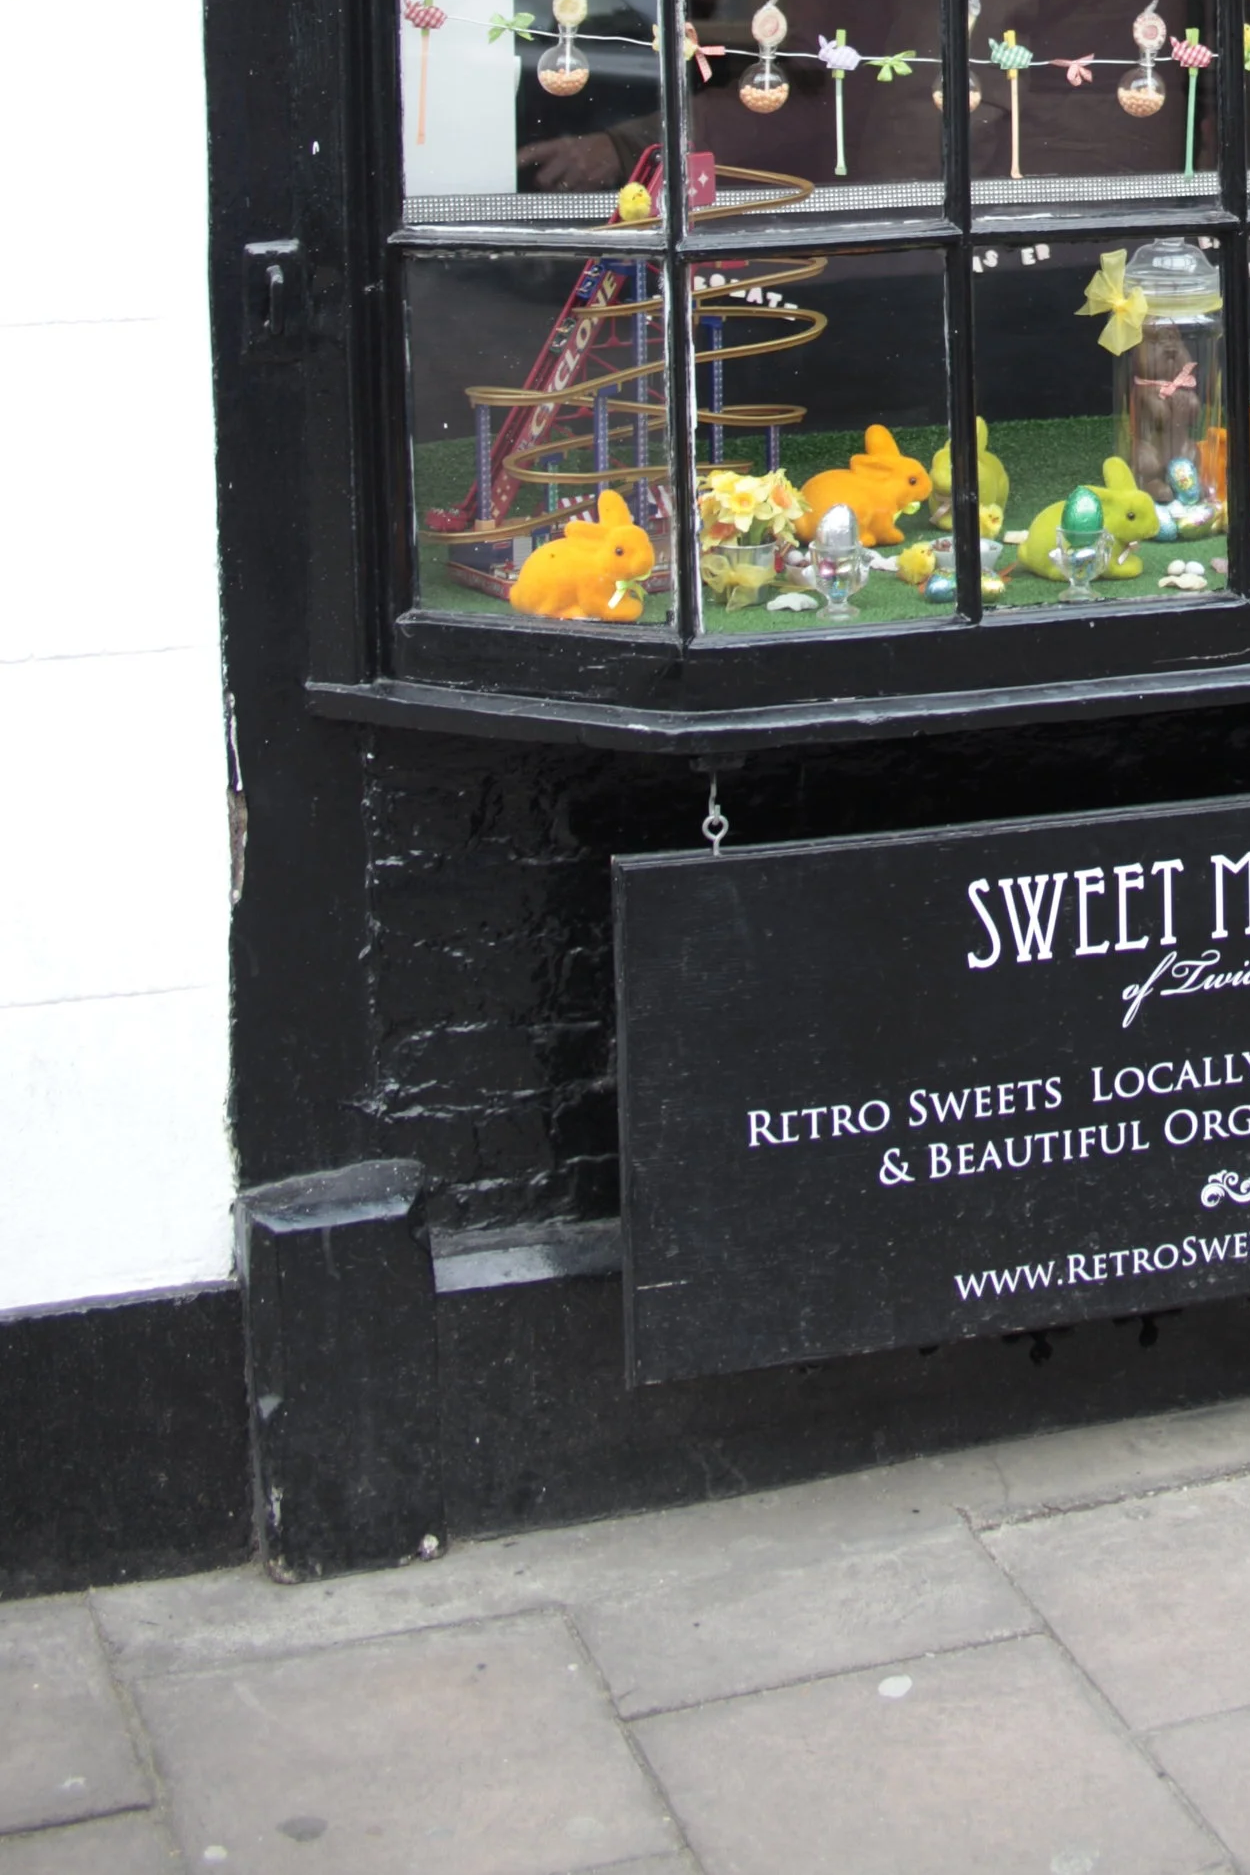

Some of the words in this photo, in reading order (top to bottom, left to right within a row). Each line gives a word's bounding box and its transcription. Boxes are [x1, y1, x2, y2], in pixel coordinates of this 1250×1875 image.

[967, 858, 1185, 969] SWEET
[1121, 951, 1178, 1029] of
[747, 1099, 891, 1147] RETRO
[908, 1076, 1062, 1127] SWEETS
[879, 1147, 916, 1186] &
[927, 1120, 1150, 1179] BEAUTIFUL
